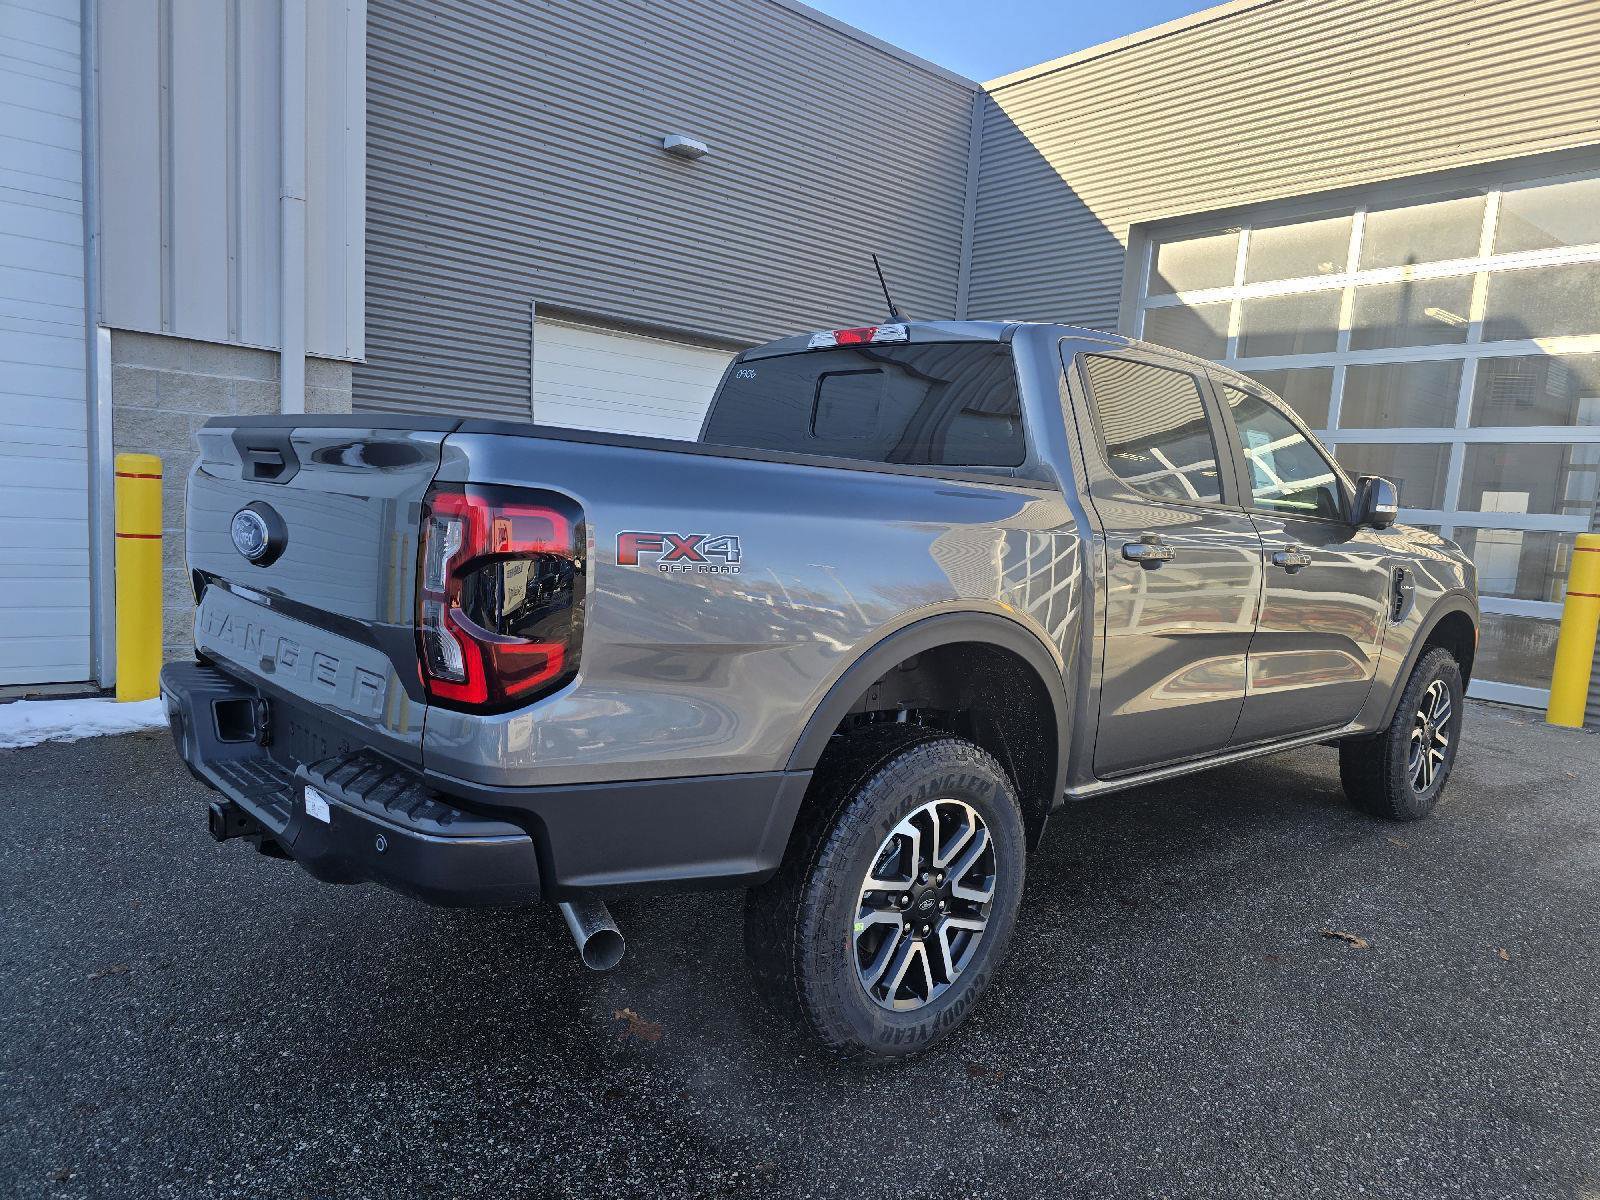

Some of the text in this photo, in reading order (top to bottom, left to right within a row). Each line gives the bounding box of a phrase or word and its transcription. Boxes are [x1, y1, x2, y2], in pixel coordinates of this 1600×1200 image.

[615, 530, 742, 567] FX4
[658, 564, 741, 574] OFF ROAD
